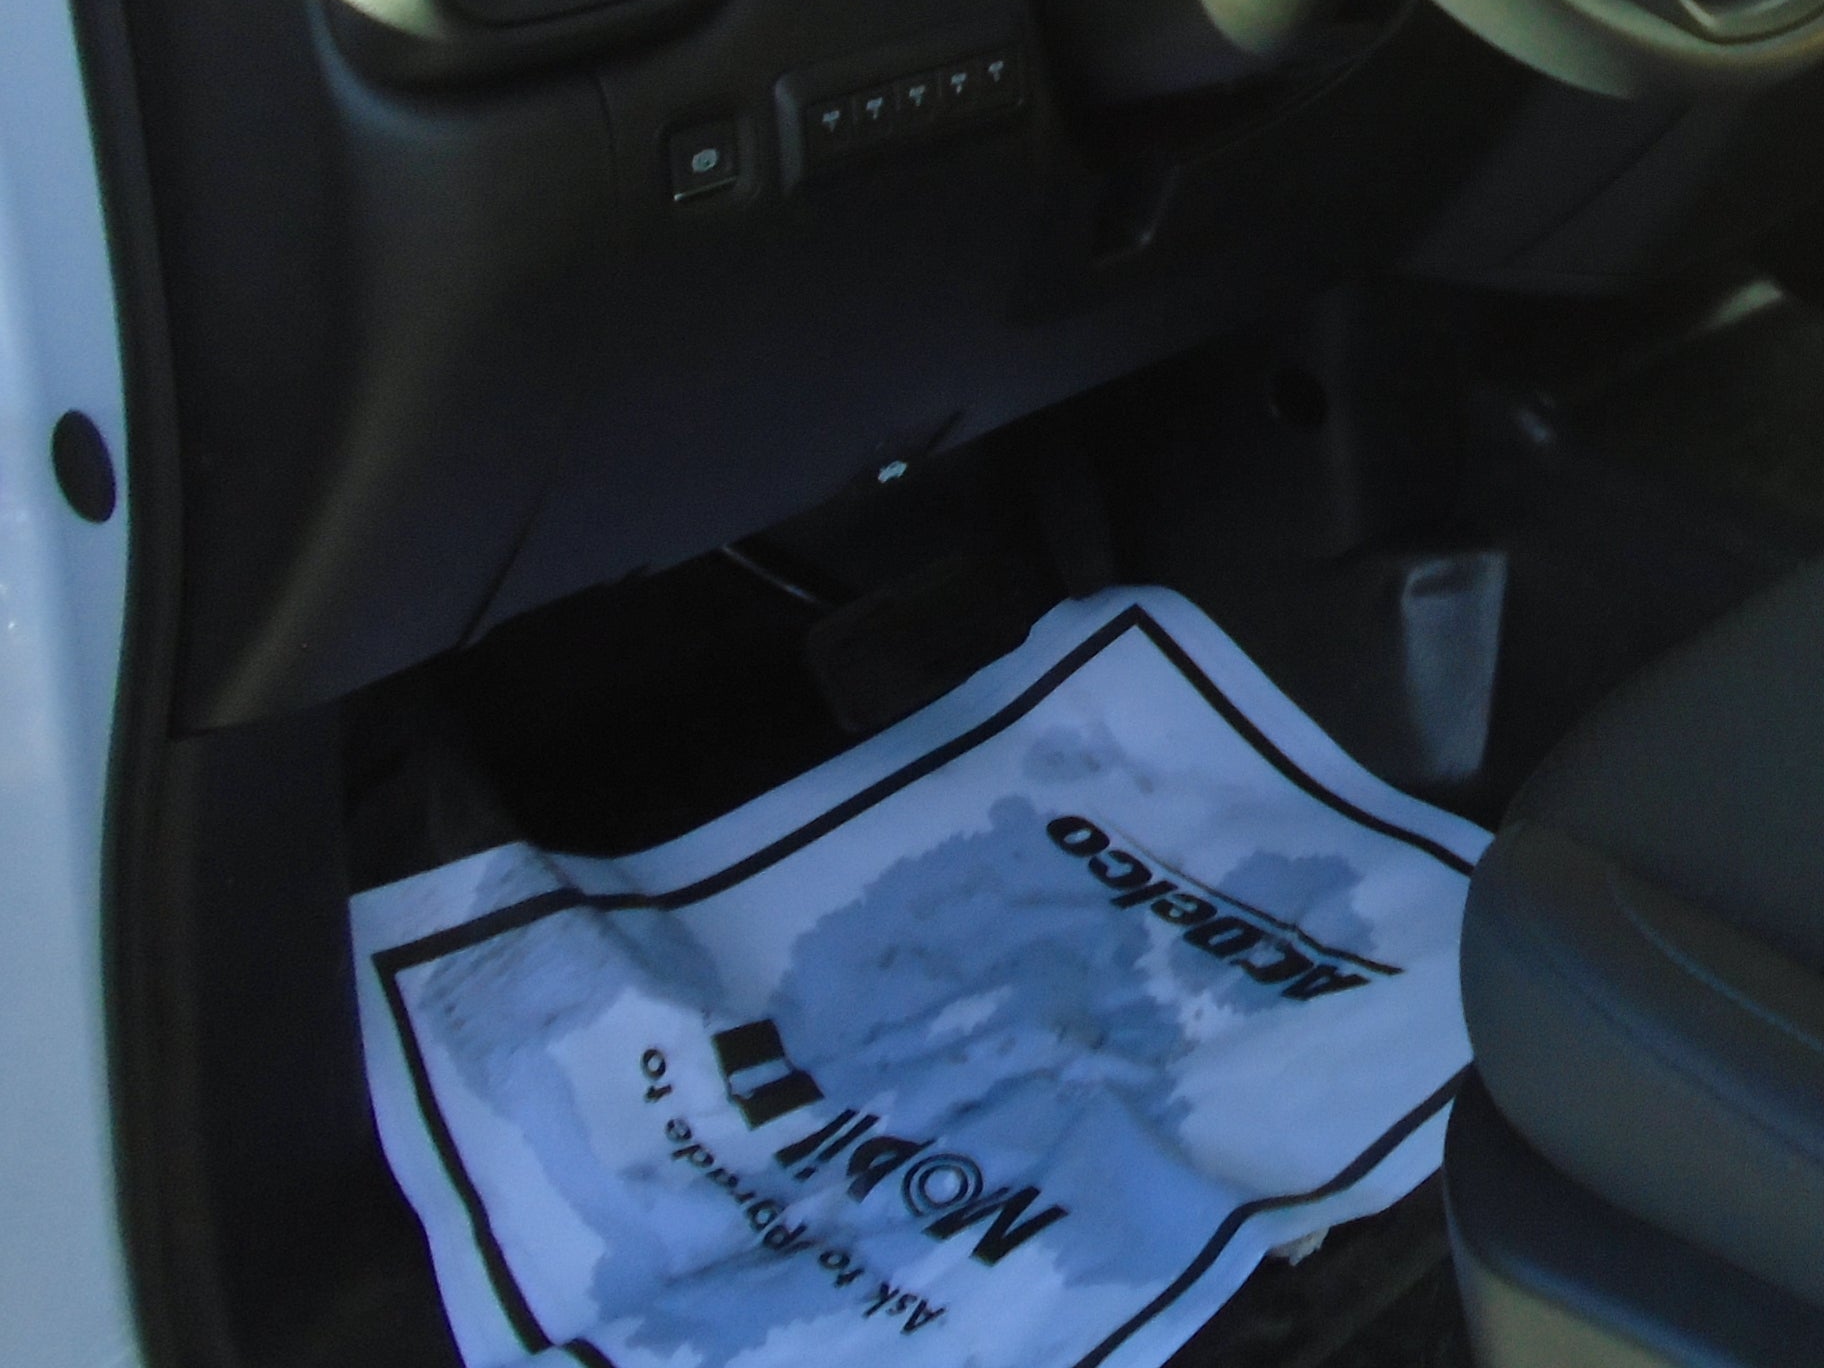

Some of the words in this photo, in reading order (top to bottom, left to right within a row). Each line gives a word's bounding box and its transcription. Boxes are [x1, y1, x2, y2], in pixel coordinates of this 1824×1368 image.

[1047, 815, 1371, 1001] ACDelco
[640, 1048, 672, 1104] to
[774, 1108, 1069, 1267] Mobil
[819, 1248, 868, 1288] to
[862, 1283, 946, 1336] Ask
